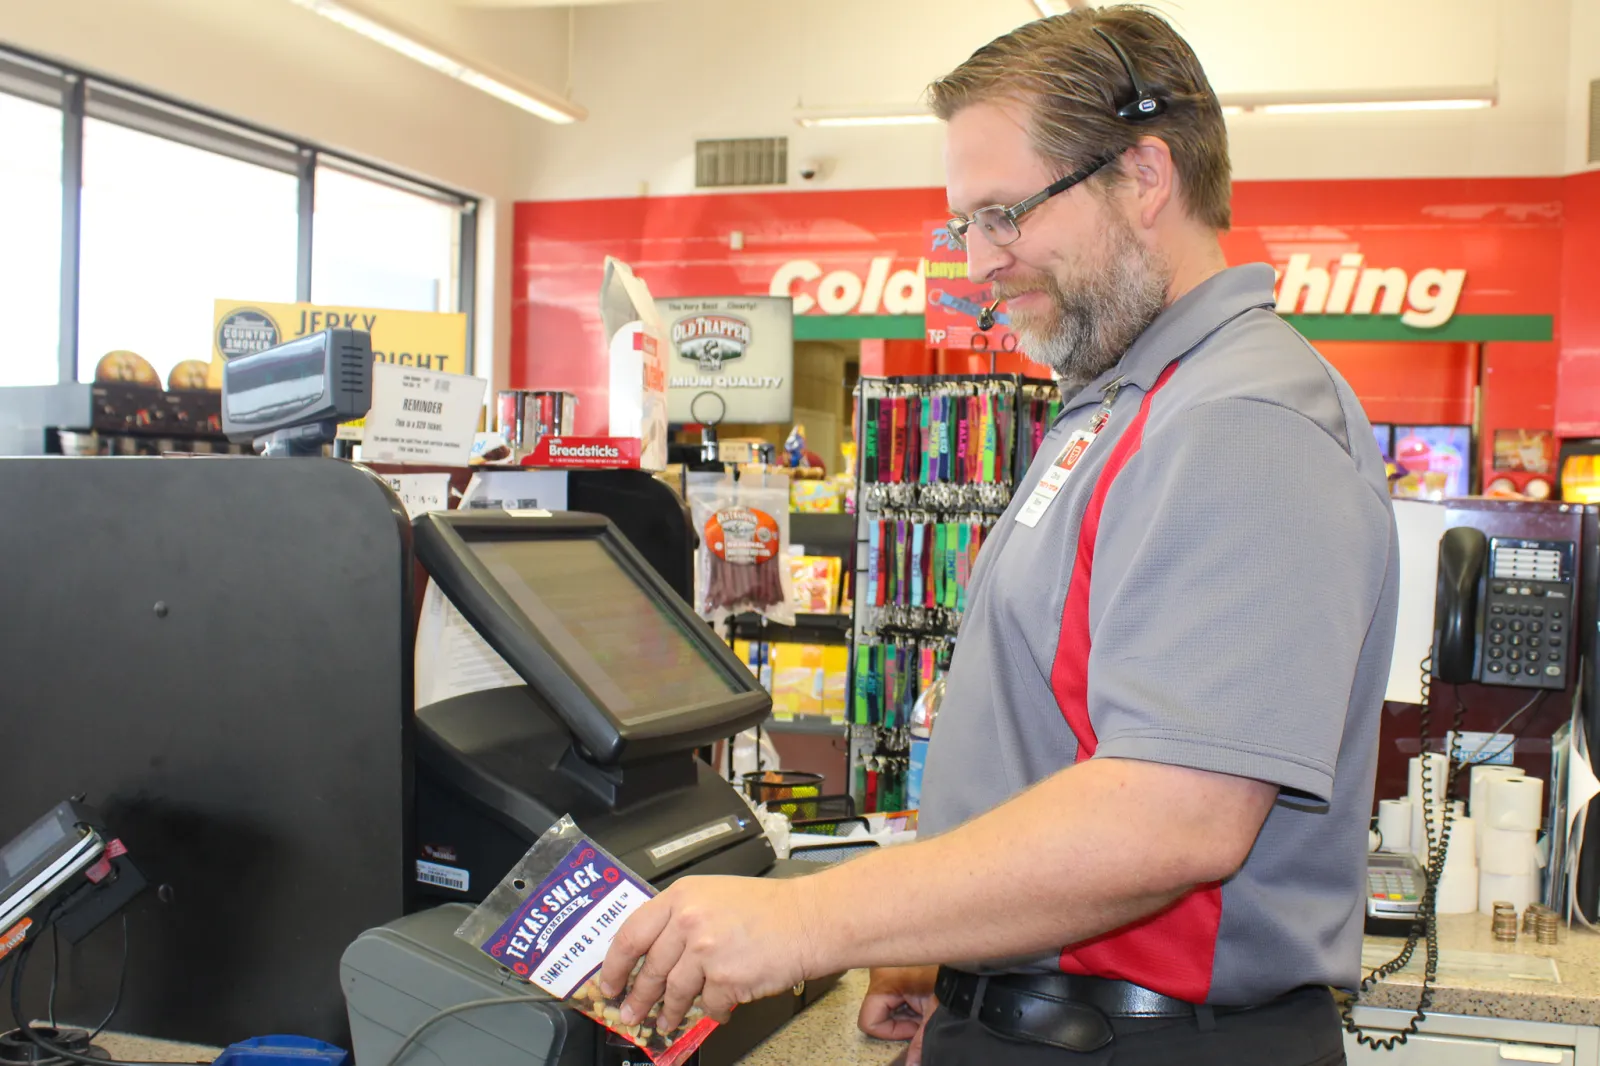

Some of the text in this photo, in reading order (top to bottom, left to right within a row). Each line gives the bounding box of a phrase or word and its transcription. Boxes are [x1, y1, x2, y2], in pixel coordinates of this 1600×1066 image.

[770, 256, 925, 316] Cold
[1274, 253, 1467, 328] hing
[223, 328, 273, 340] COUNTRY
[673, 316, 751, 341] OLD TRAPPER
[670, 376, 783, 389] MIUM QUALITY
[402, 398, 443, 414] REMINDER
[549, 444, 619, 458] Breadsticks
[506, 862, 602, 959] TEXAS SNACK
[541, 900, 580, 941] COMPANY
[540, 953, 574, 985] SIMPLY
[569, 941, 587, 957] PB
[582, 934, 594, 945] &
[591, 926, 601, 936] J
